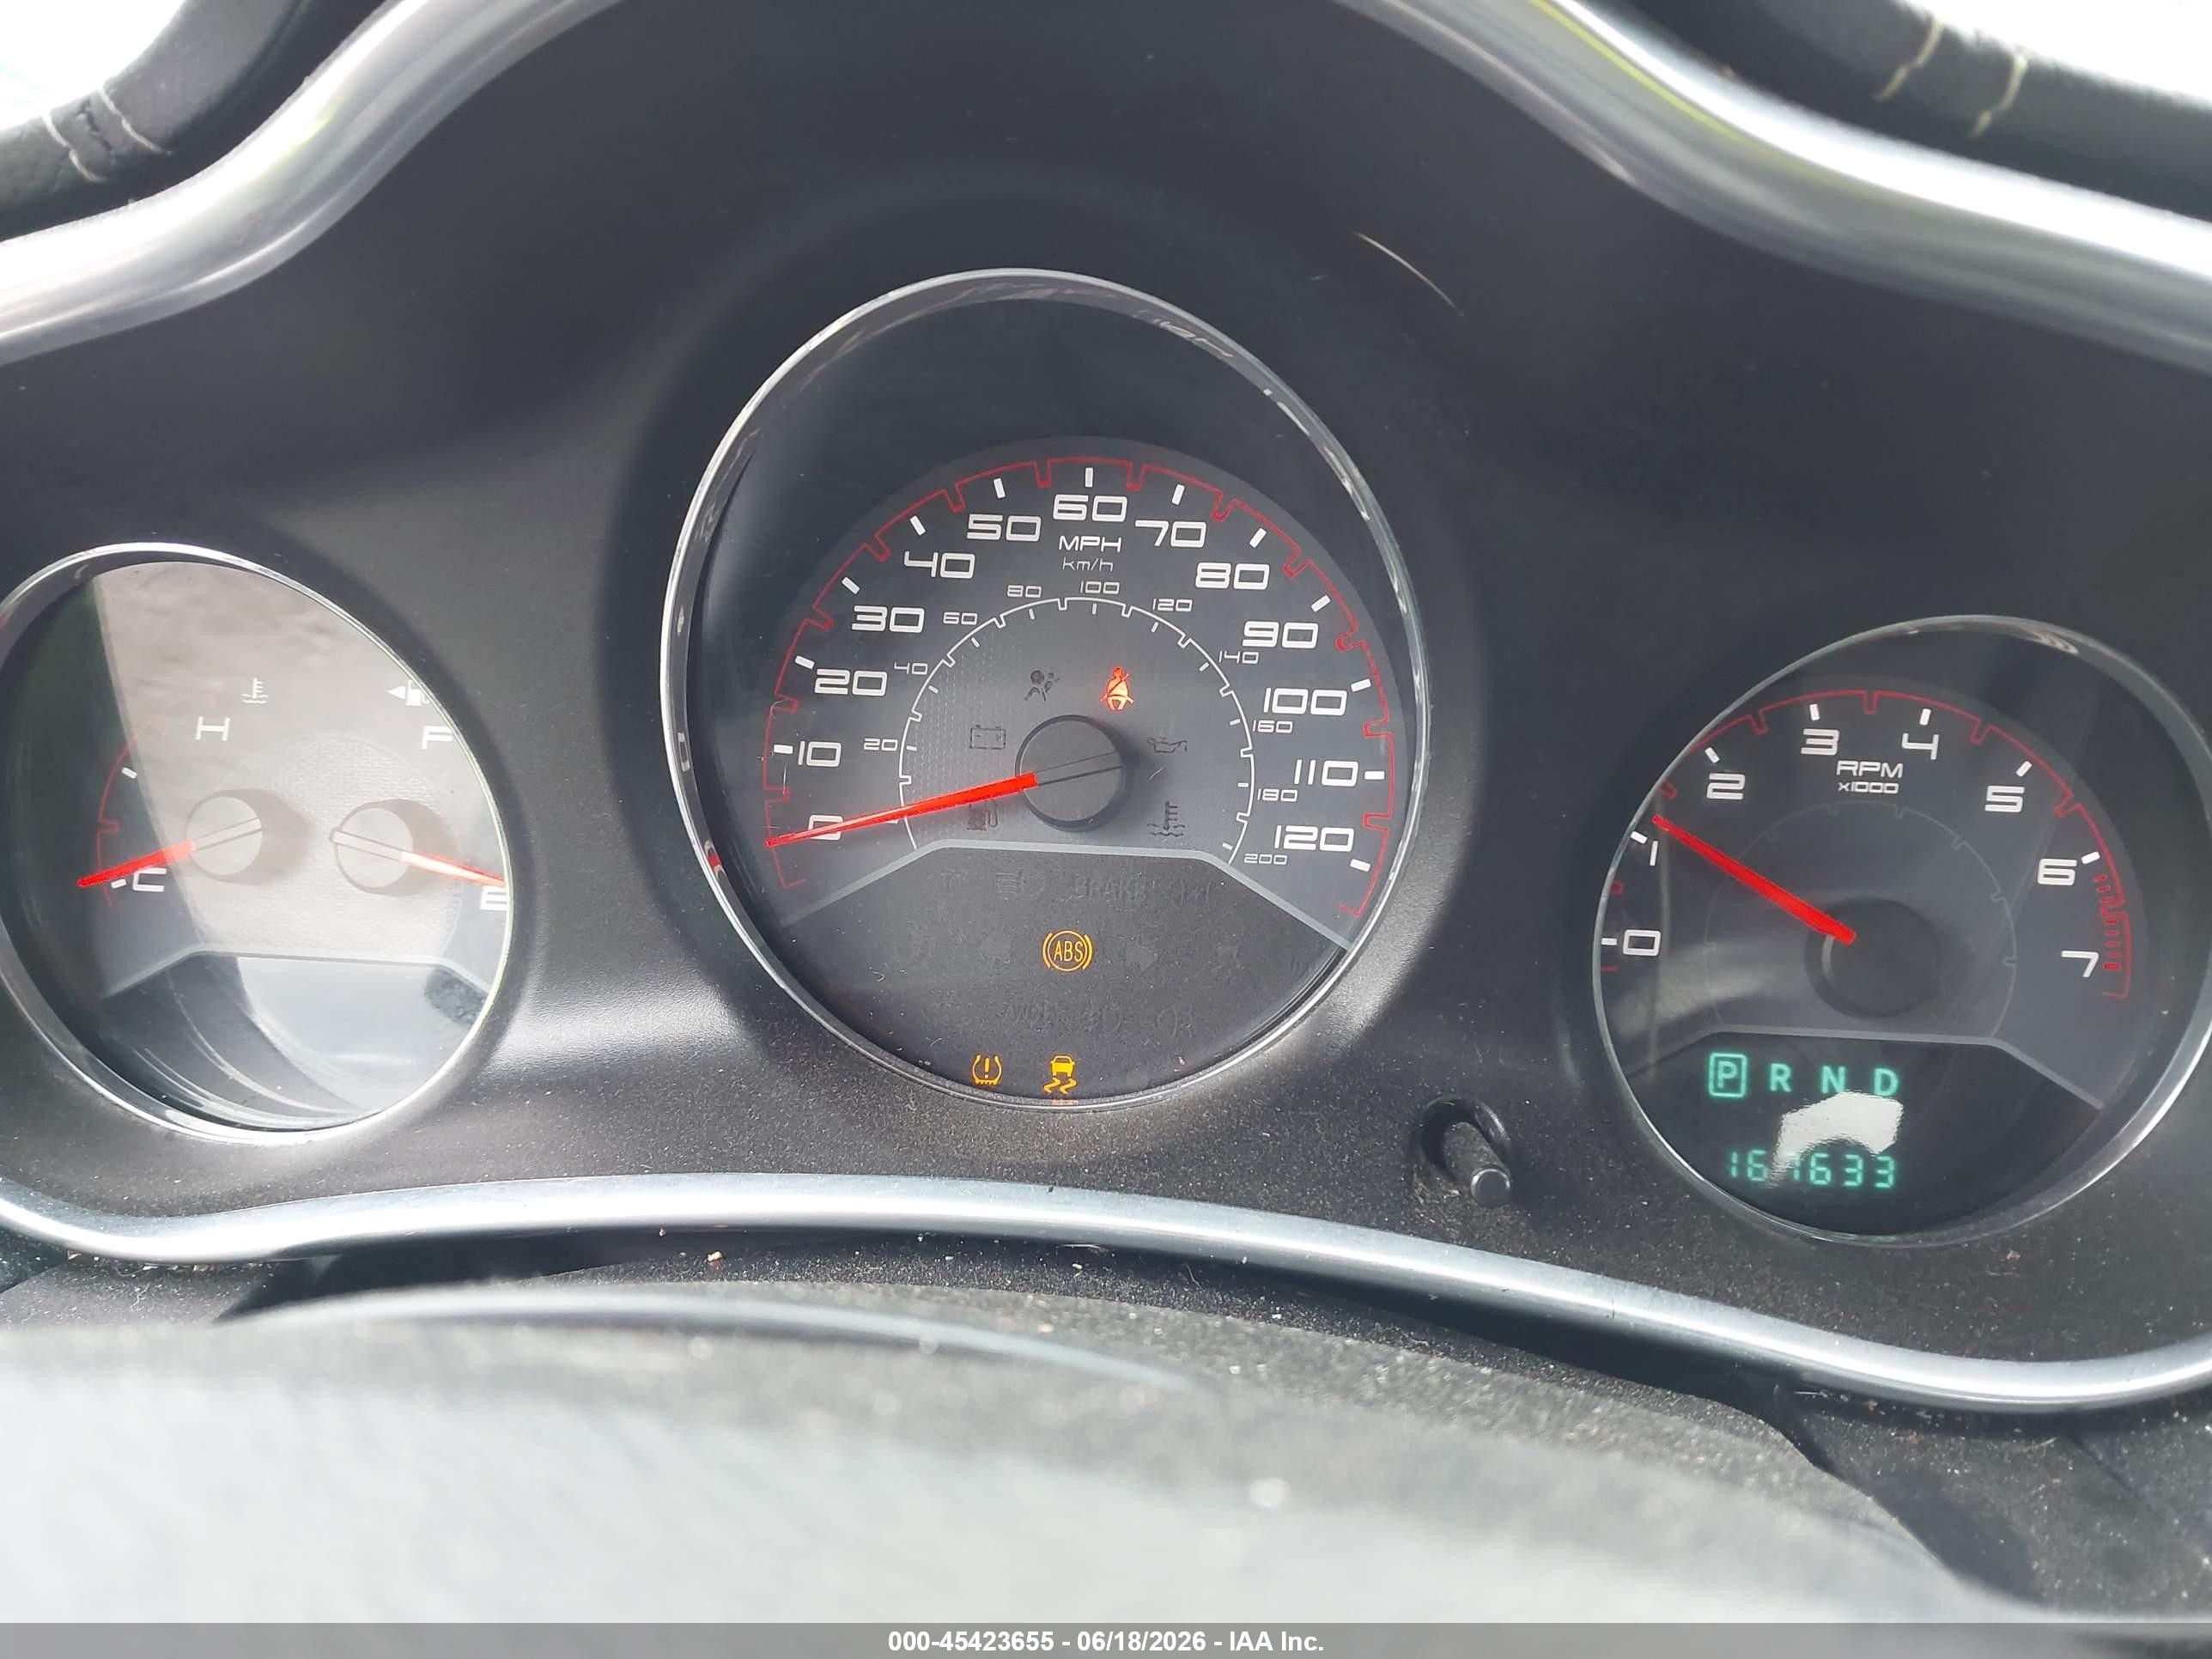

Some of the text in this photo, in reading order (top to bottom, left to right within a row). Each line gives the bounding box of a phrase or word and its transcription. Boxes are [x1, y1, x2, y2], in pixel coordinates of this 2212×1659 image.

[1053, 494, 1127, 522] 60
[966, 514, 1042, 542] 50
[1134, 520, 1206, 548] 70
[1058, 535, 1122, 553] MPH
[903, 550, 975, 579] 40
[1062, 556, 1114, 572] km/h
[1195, 562, 1270, 590] 80
[1006, 585, 1042, 599] 80
[1079, 580, 1121, 595] 100
[943, 611, 978, 625] 60
[1152, 598, 1193, 612] 120
[851, 605, 925, 634] 30
[1242, 621, 1319, 649] 90
[893, 662, 928, 676] 40
[1218, 650, 1260, 665] 140
[814, 668, 888, 696] 20
[1263, 687, 1347, 716] 100
[195, 716, 231, 742] H
[421, 725, 455, 750] F
[1252, 720, 1293, 733] 160
[798, 740, 842, 768] 10
[863, 738, 898, 751] 20
[1801, 728, 1839, 756] 3
[1901, 732, 1940, 761] 4
[1294, 759, 1358, 787] 110
[1836, 760, 1904, 779] RPM
[1256, 788, 1298, 802] 180
[1706, 773, 1746, 800] 2
[1838, 781, 1899, 794] x1000
[1984, 785, 2025, 812] 5
[808, 815, 843, 841] 0
[1274, 824, 1354, 852] 120
[1243, 853, 1288, 866] 200
[1650, 840, 1659, 866] 1
[132, 866, 167, 893] C
[2038, 858, 2077, 885] 6
[479, 884, 508, 911] E
[1053, 939, 1084, 963] ABS
[1622, 929, 1662, 957] 0
[2061, 950, 2100, 978] 7
[1717, 1060, 1899, 1097] P R N D
